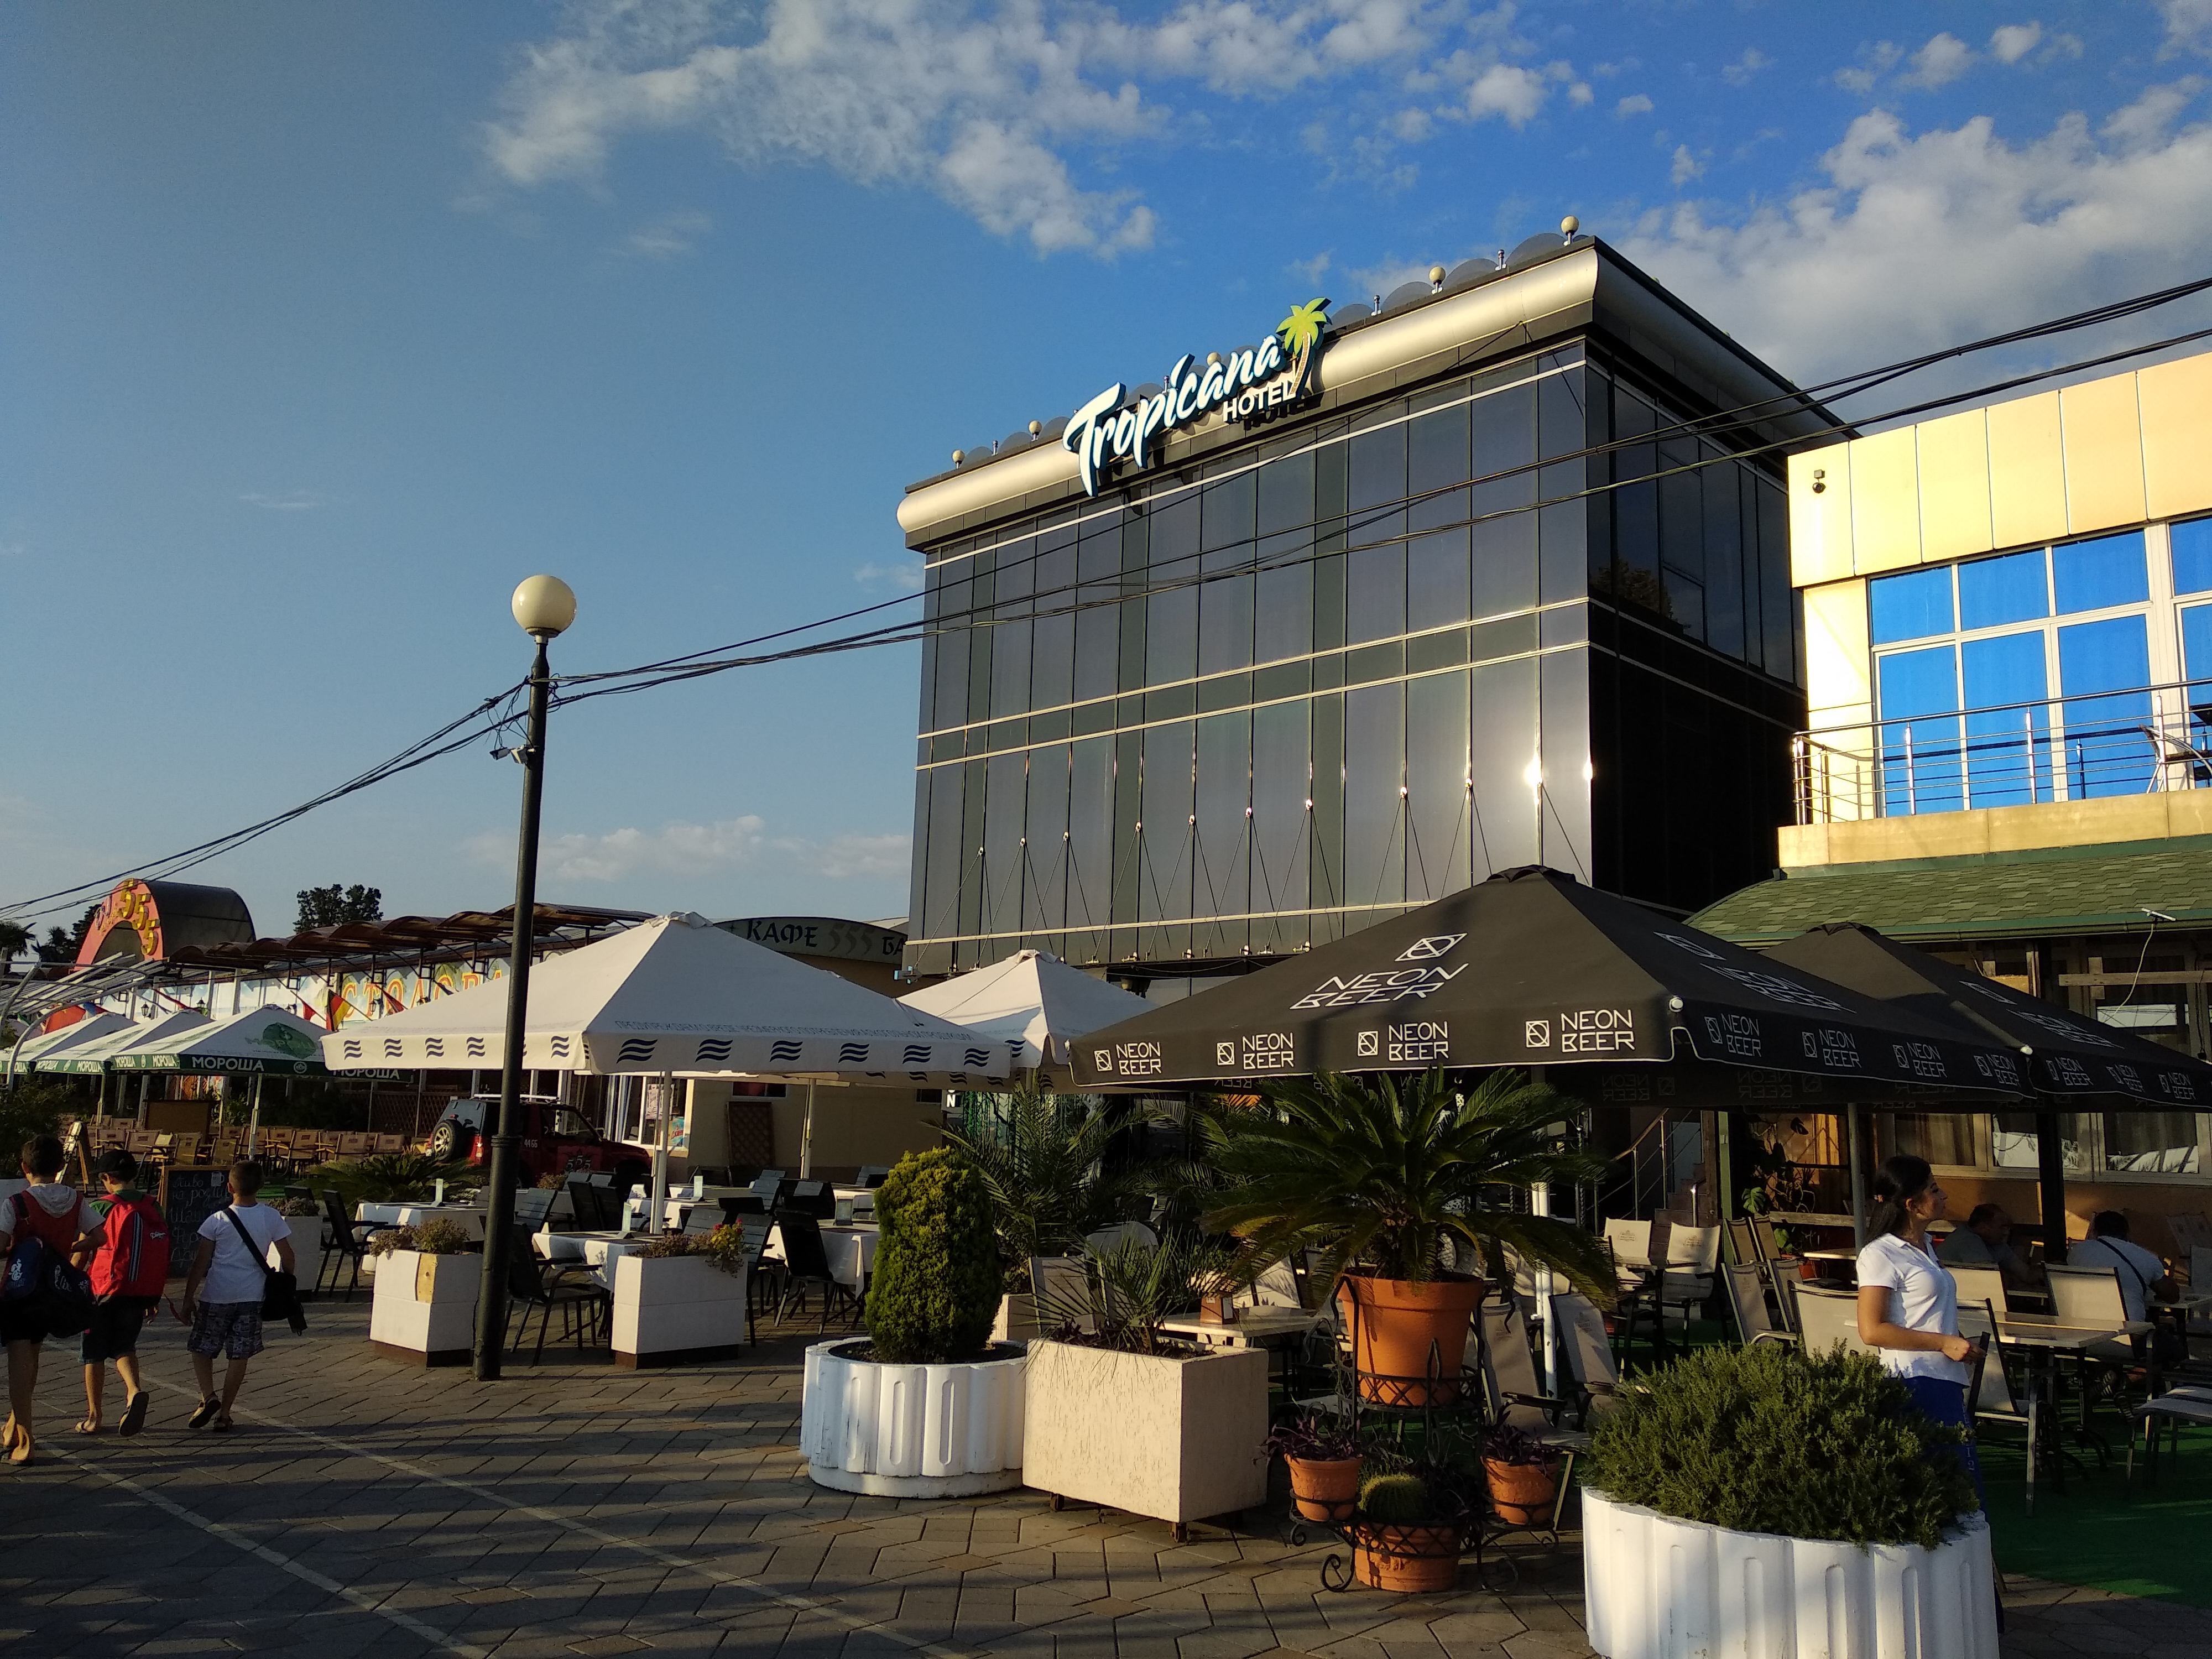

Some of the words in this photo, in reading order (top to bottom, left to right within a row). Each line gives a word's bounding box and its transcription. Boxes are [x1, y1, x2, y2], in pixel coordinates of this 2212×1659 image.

[1223, 379, 1297, 422] HOTEL
[1062, 334, 1282, 497] Tropicana
[747, 919, 818, 947] КАФЕ
[1315, 963, 1469, 992] NEON
[342, 970, 501, 1019] СТОЛО
[1289, 982, 1444, 1009] BEER
[1561, 1009, 1633, 1031] NEON
[1720, 1013, 1760, 1037] NEON
[1389, 1021, 1448, 1041] NEON
[1818, 1029, 1856, 1050] NEON
[1116, 1041, 1161, 1058] NEON
[1242, 1032, 1294, 1051] NEON
[1389, 1041, 1449, 1061] BEER
[1561, 1031, 1635, 1052] BEER
[1725, 1034, 1762, 1058] BEER
[152, 1055, 177, 1067] МОРОША
[1243, 1051, 1295, 1070] BEER
[1823, 1048, 1863, 1069] BEER
[1906, 1042, 1942, 1061] NEON
[76, 1061, 103, 1073] МОРОША
[114, 1056, 136, 1068] МОРОША
[192, 1056, 264, 1072] МОРОША
[1119, 1058, 1161, 1075] BEER
[1912, 1059, 1948, 1078] BEER
[1985, 1053, 2017, 1072] NEON
[2054, 1056, 2084, 1072] NEON
[2114, 1063, 2139, 1079] NEON
[1994, 1068, 2022, 1088] BEER
[2062, 1071, 2094, 1086] BEER
[2122, 1077, 2146, 1093] BEER
[2167, 1072, 2192, 1086] NEON
[2171, 1086, 2197, 1100] BEER
